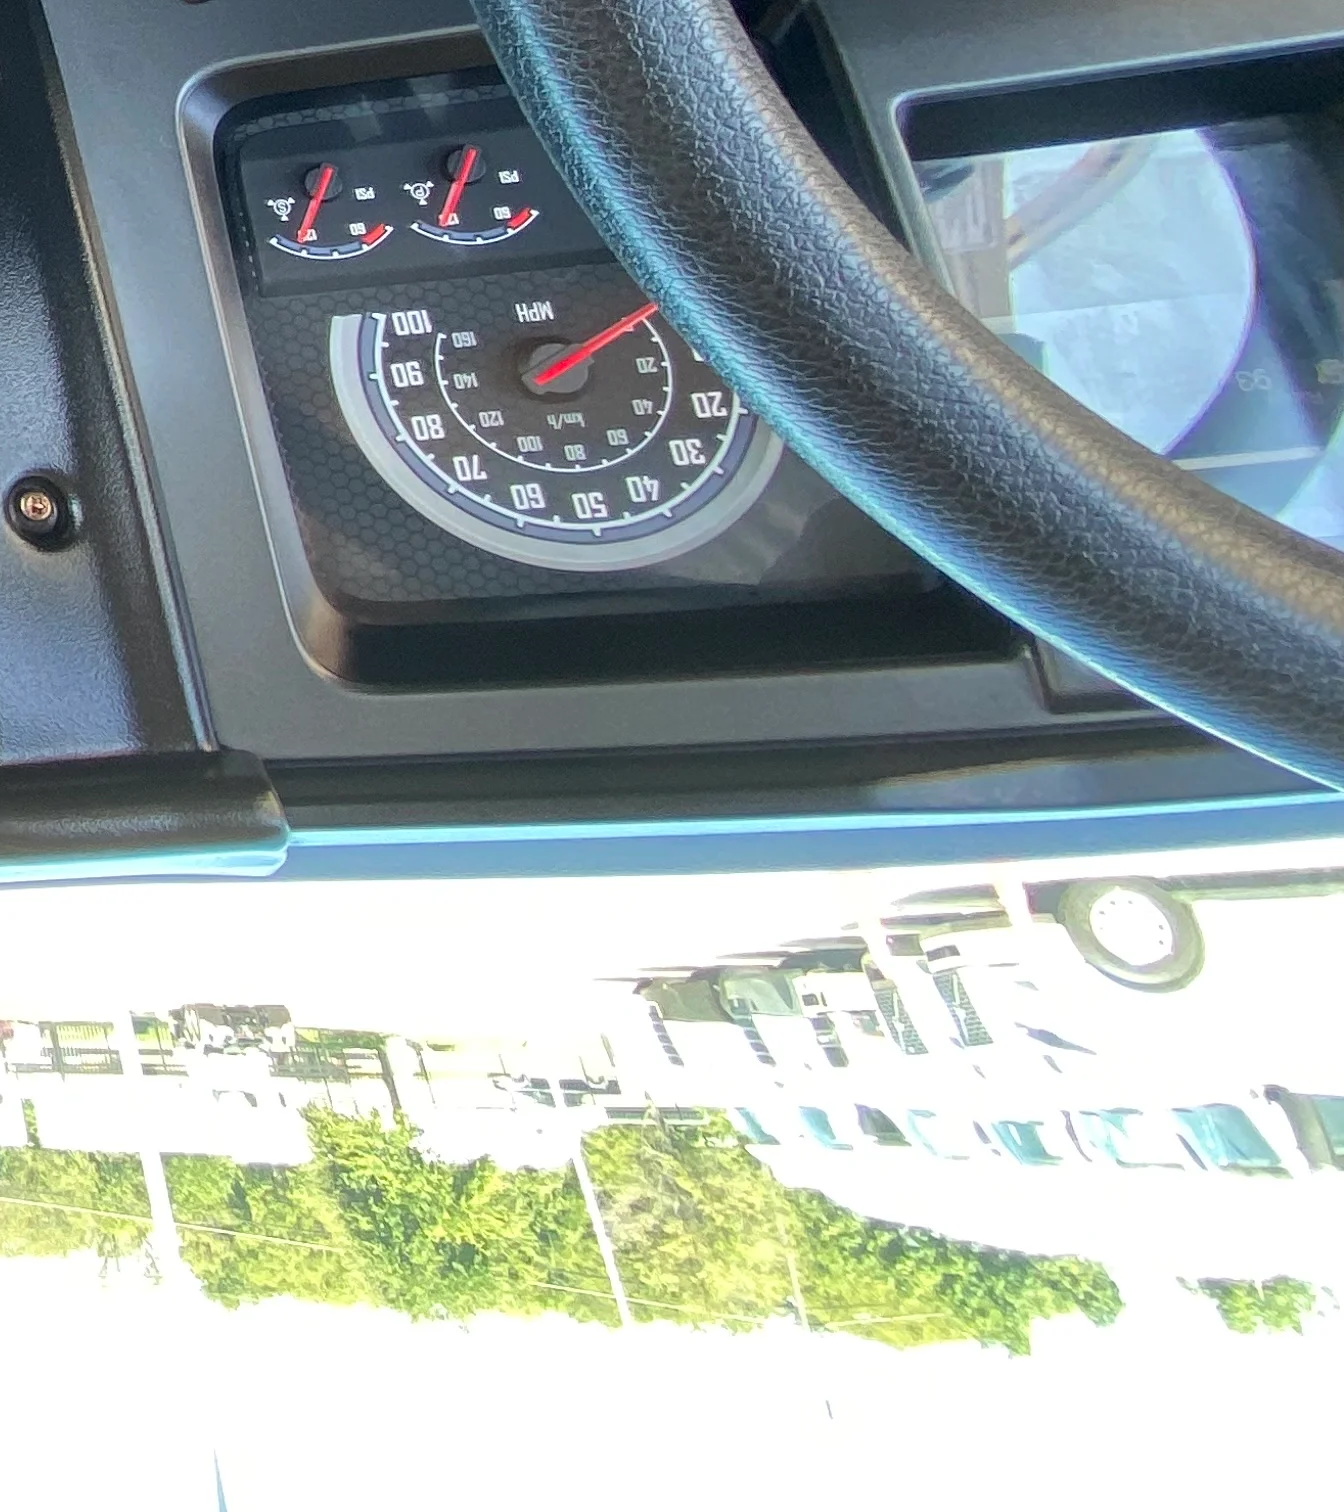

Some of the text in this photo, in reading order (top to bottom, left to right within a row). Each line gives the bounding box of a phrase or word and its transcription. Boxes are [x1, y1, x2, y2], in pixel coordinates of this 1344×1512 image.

[498, 170, 519, 183] PSI
[354, 187, 375, 200] PSI
[515, 300, 554, 323] MPH
[392, 309, 432, 336] 100
[452, 331, 477, 347] 160
[635, 356, 658, 373] 20
[391, 361, 425, 387] 90
[453, 372, 478, 388] 140
[631, 399, 653, 415] 40
[691, 391, 727, 418] 20
[478, 410, 504, 427] 120
[547, 412, 585, 429] km/h
[410, 414, 445, 441] 80
[516, 436, 543, 452] 100
[606, 428, 628, 445] 60
[565, 444, 586, 460] 80
[669, 438, 706, 466] 30
[453, 455, 487, 481] 70
[510, 483, 545, 510] 60
[626, 475, 660, 503] 40
[571, 491, 608, 518] 50
